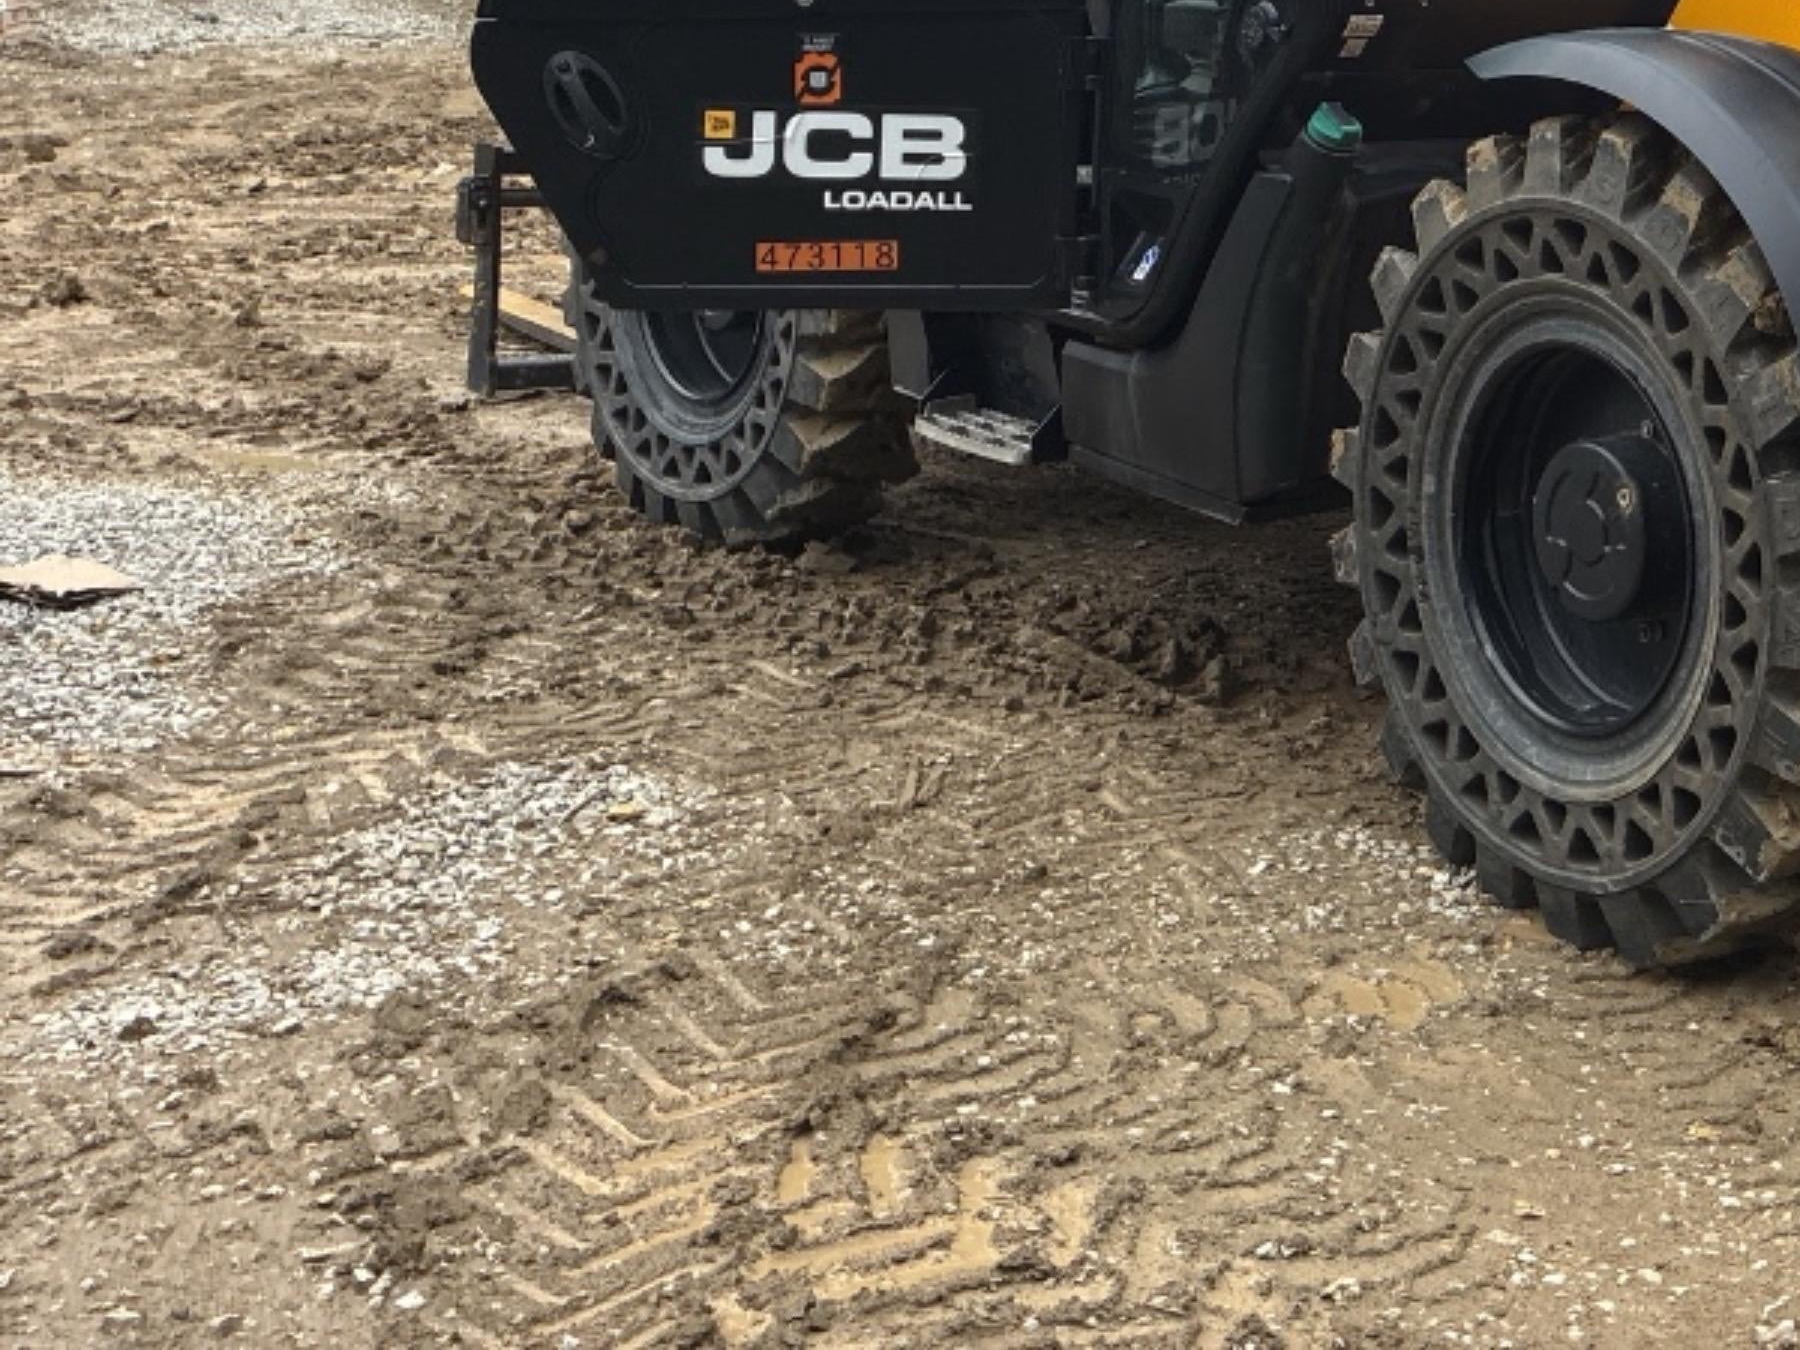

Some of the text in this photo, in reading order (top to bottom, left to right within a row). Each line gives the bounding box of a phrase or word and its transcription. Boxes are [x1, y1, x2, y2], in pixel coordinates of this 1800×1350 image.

[703, 110, 967, 180] JCB
[823, 190, 973, 210] LOADALL
[759, 243, 895, 267] 473118
